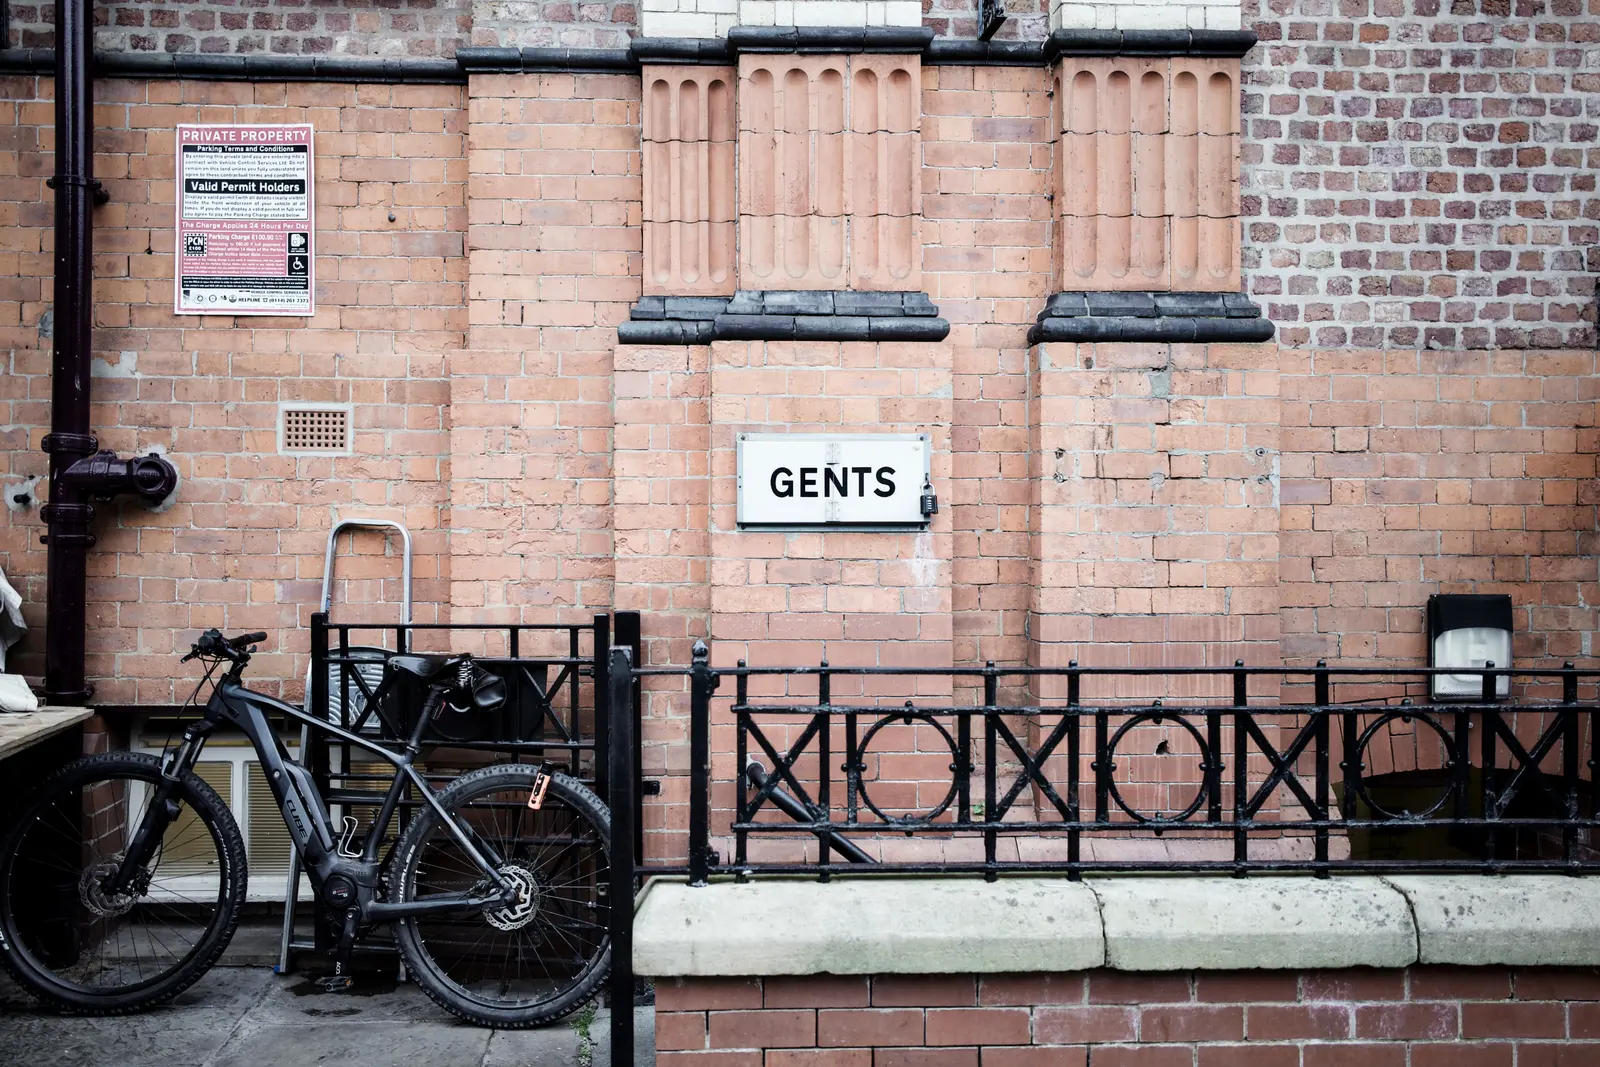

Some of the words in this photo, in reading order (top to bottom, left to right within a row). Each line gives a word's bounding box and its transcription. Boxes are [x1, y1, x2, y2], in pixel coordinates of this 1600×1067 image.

[183, 131, 236, 141] PRIVATE
[241, 131, 307, 141] PROPERTY
[191, 182, 218, 191] Valid
[221, 182, 256, 191] Permit
[259, 182, 300, 191] Holders
[188, 237, 204, 245] PCN
[770, 466, 896, 498] GENTS
[285, 799, 308, 839] CUBE
